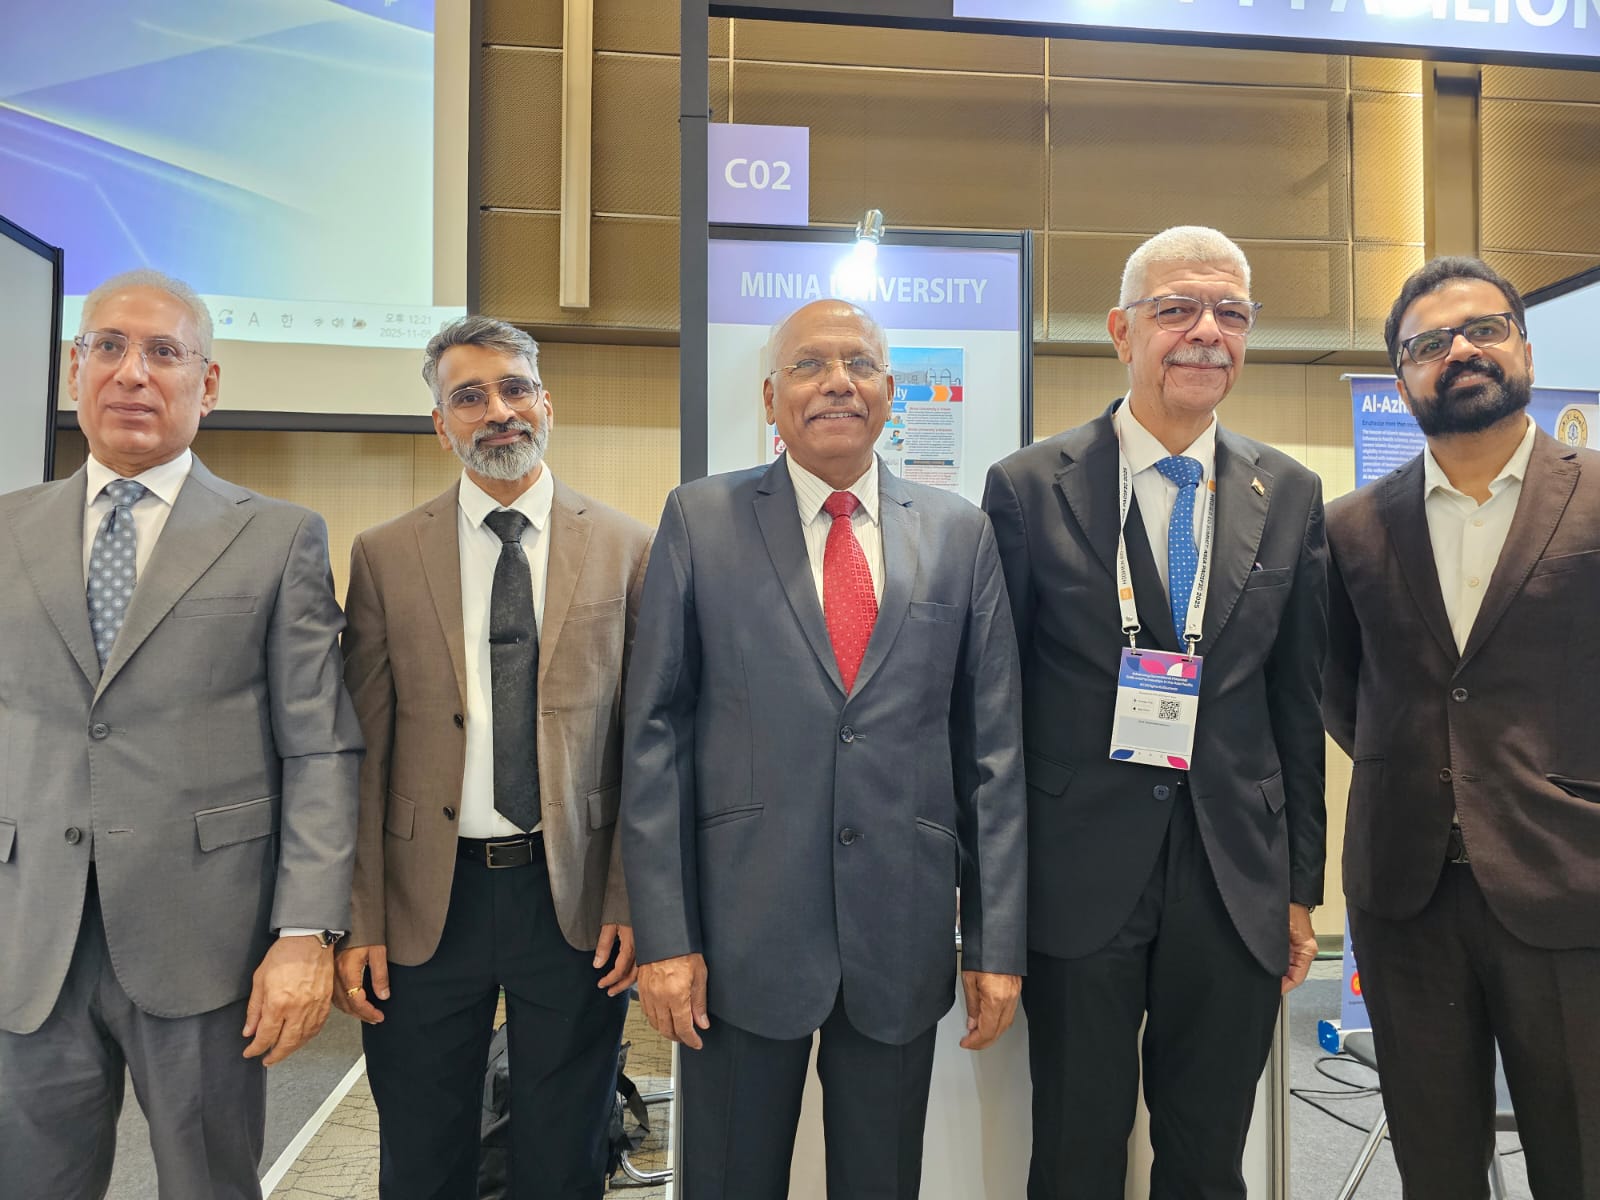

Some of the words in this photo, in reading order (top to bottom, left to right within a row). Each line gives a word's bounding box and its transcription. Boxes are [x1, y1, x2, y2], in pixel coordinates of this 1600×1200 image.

[725, 158, 791, 190] C02
[741, 271, 822, 299] MINIA
[830, 273, 988, 304] VERSITY
[1362, 395, 1409, 414] Al-Azh
